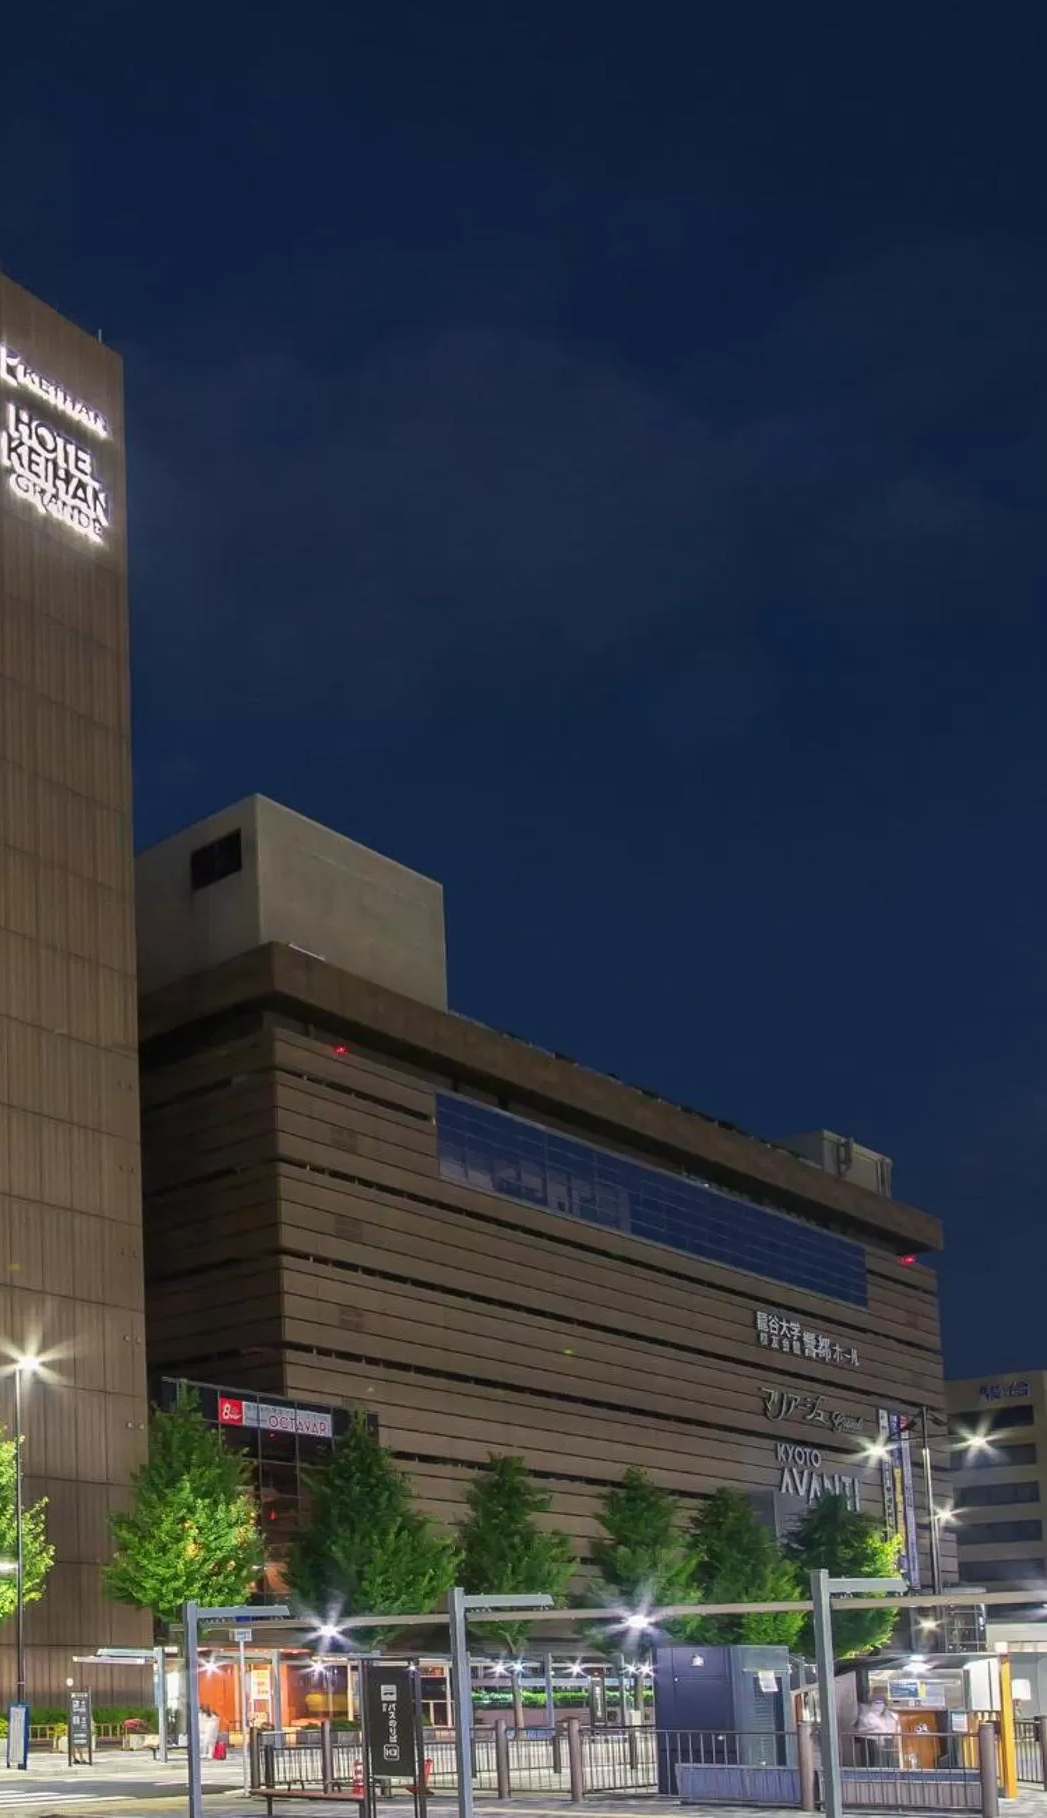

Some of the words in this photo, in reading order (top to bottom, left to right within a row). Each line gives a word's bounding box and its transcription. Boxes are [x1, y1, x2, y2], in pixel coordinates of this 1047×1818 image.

[17, 363, 109, 439] KEIHAN
[0, 430, 109, 527] KEIHAN
[9, 473, 105, 545] GRANDE
[777, 1443, 821, 1468] KYOTO
[780, 1467, 861, 1513] AVANTI
